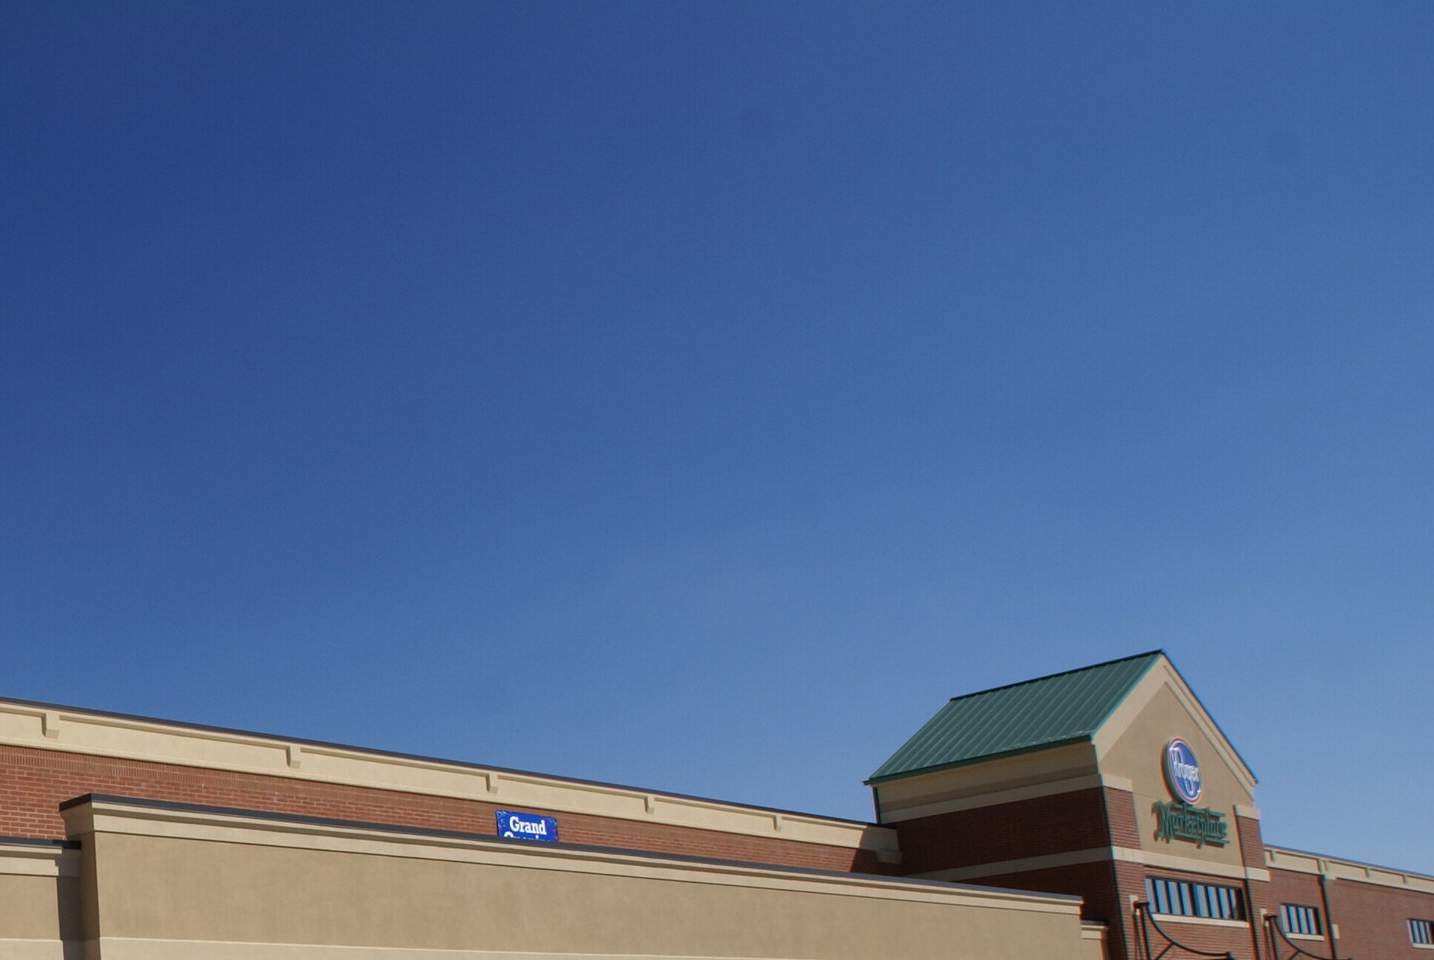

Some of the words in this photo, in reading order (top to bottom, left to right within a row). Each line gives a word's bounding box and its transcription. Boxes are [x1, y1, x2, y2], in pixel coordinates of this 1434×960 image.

[1169, 747, 1200, 796] Kroger
[509, 816, 547, 835] Grand
[1156, 800, 1228, 842] Marketplace
